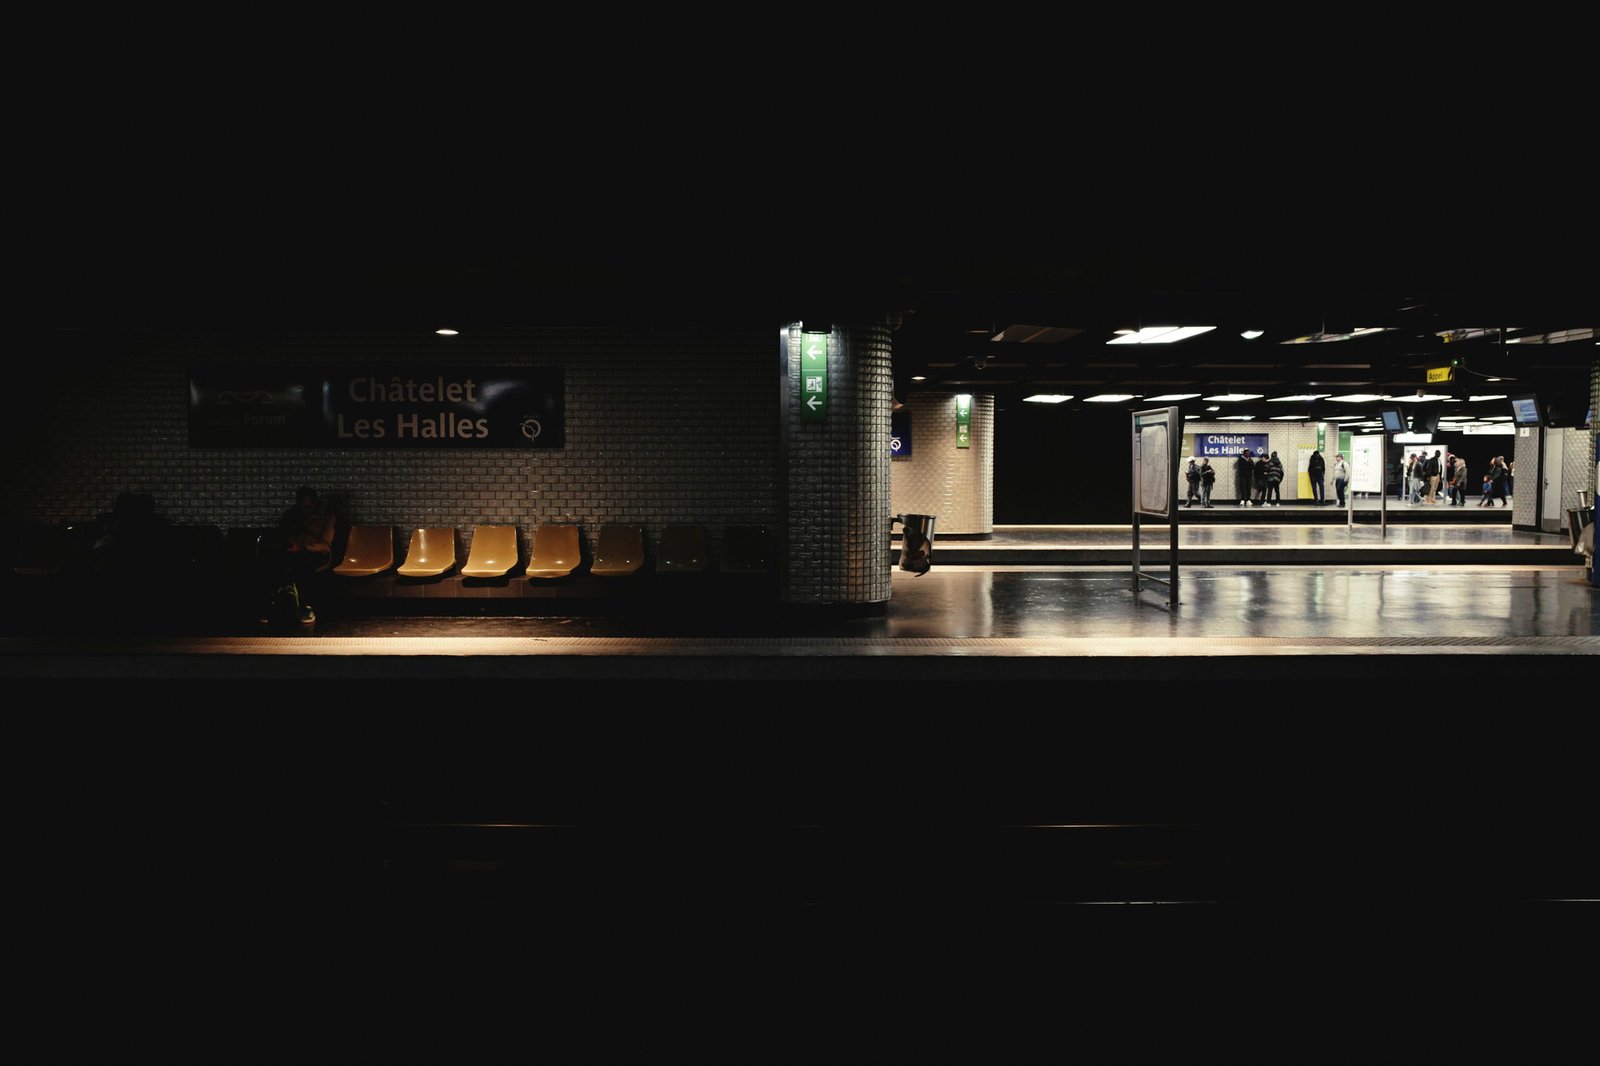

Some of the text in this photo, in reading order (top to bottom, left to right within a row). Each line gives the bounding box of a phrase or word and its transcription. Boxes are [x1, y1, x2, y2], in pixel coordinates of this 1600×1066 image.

[1428, 371, 1443, 381] Appel
[348, 376, 477, 403] Châtelet
[243, 414, 286, 425] Forum
[337, 412, 489, 439] Les Halles
[1208, 435, 1246, 445] Châtelet
[1204, 446, 1219, 455] Les
